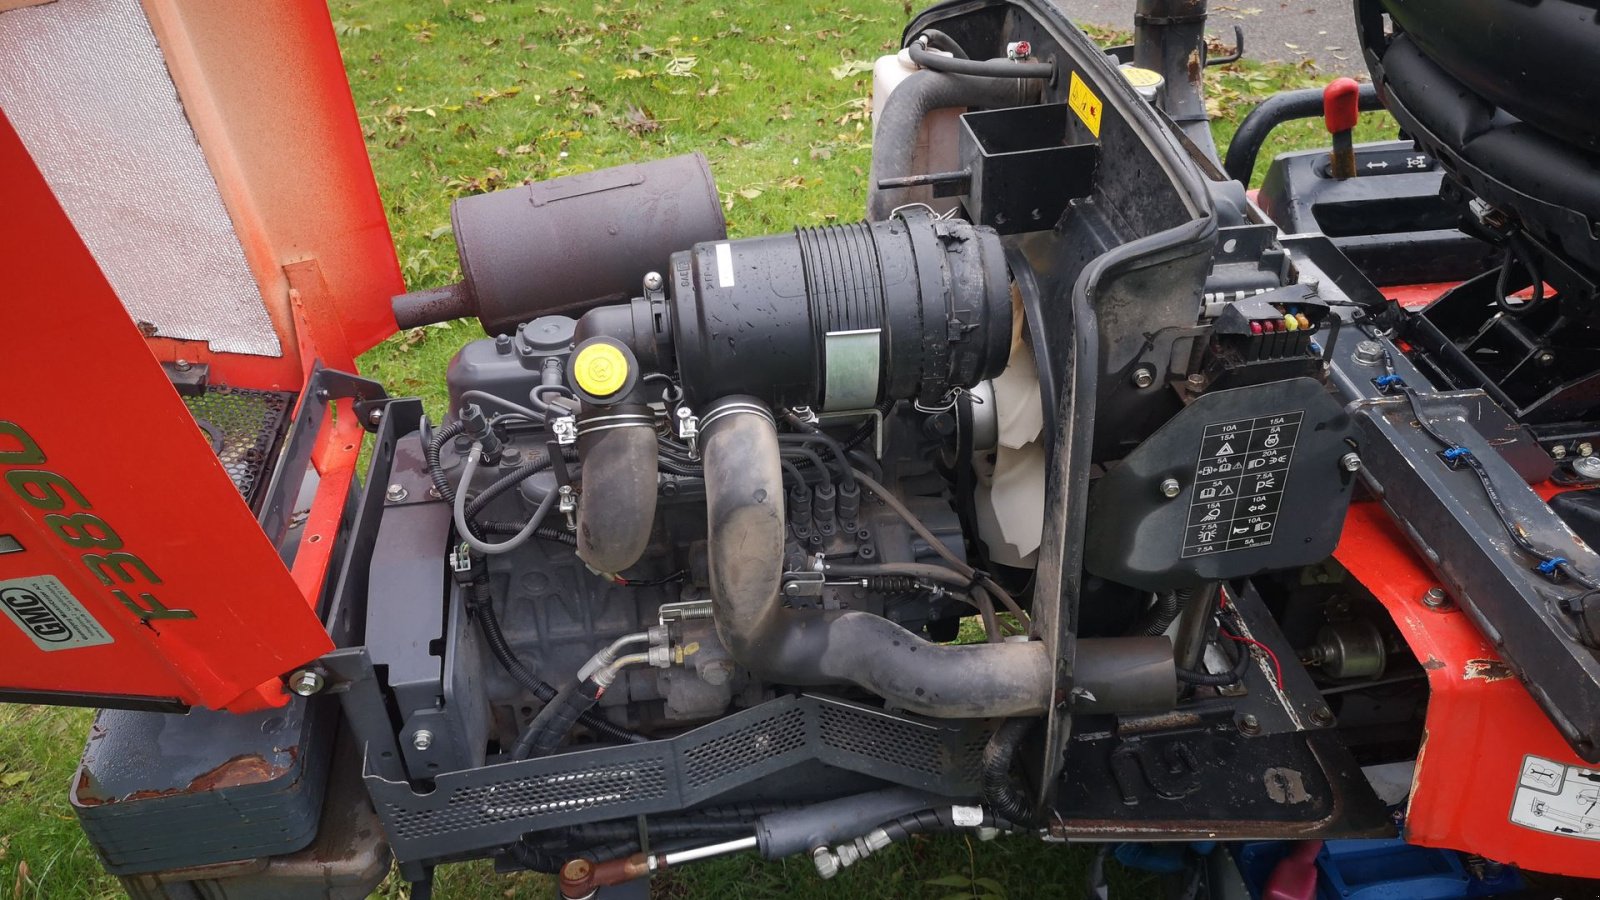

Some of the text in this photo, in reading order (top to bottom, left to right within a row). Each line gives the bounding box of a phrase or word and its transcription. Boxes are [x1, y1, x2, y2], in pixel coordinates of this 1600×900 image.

[1270, 417, 1284, 425] 15A
[1222, 424, 1237, 432] 10A
[1256, 472, 1273, 480] 7.5A
[6, 594, 67, 636] GMC
